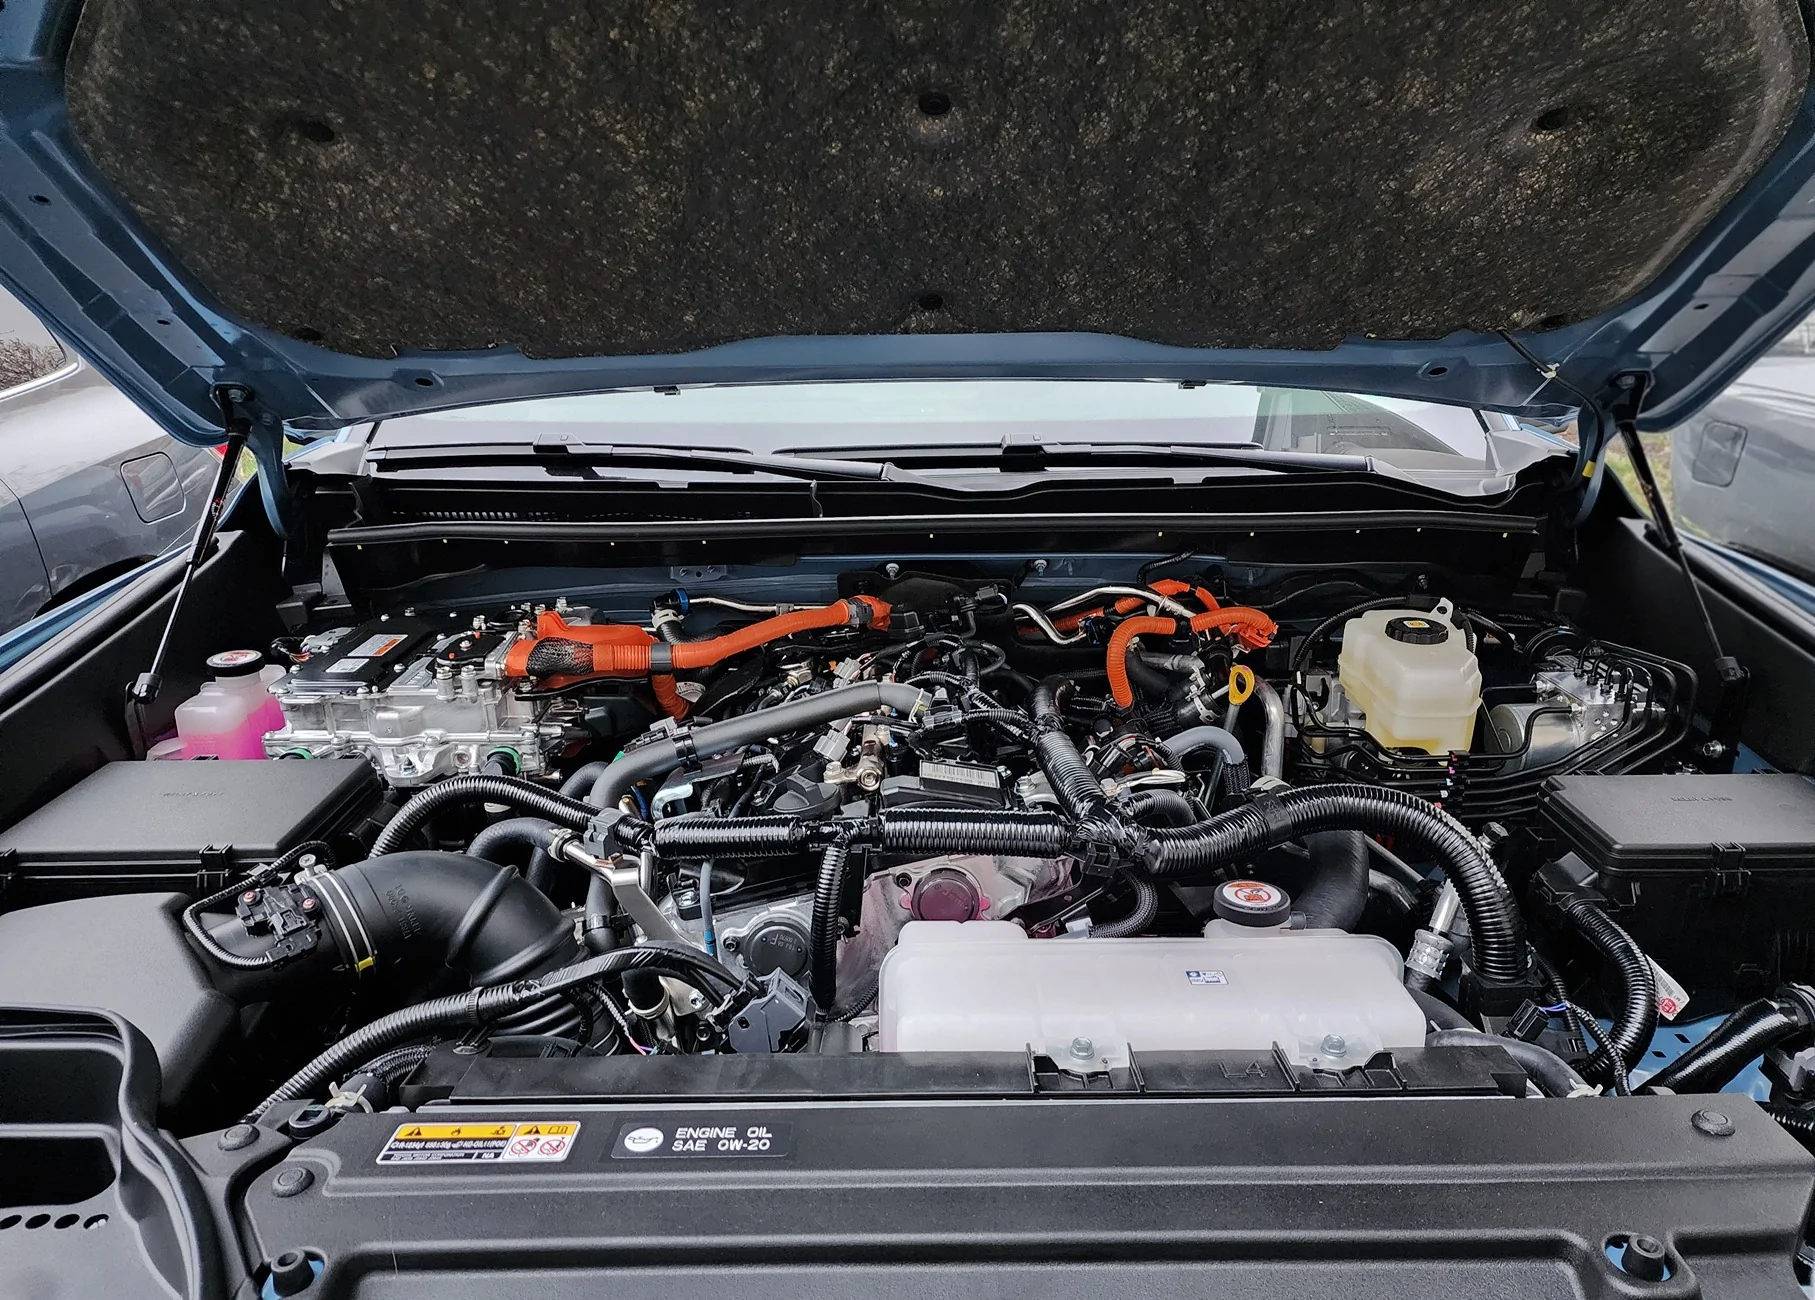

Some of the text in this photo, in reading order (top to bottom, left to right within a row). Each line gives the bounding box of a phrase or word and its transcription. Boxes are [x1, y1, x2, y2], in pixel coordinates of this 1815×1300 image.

[675, 1126, 773, 1139] ENGINE OIL
[672, 1139, 771, 1151] SAE 0W-20
